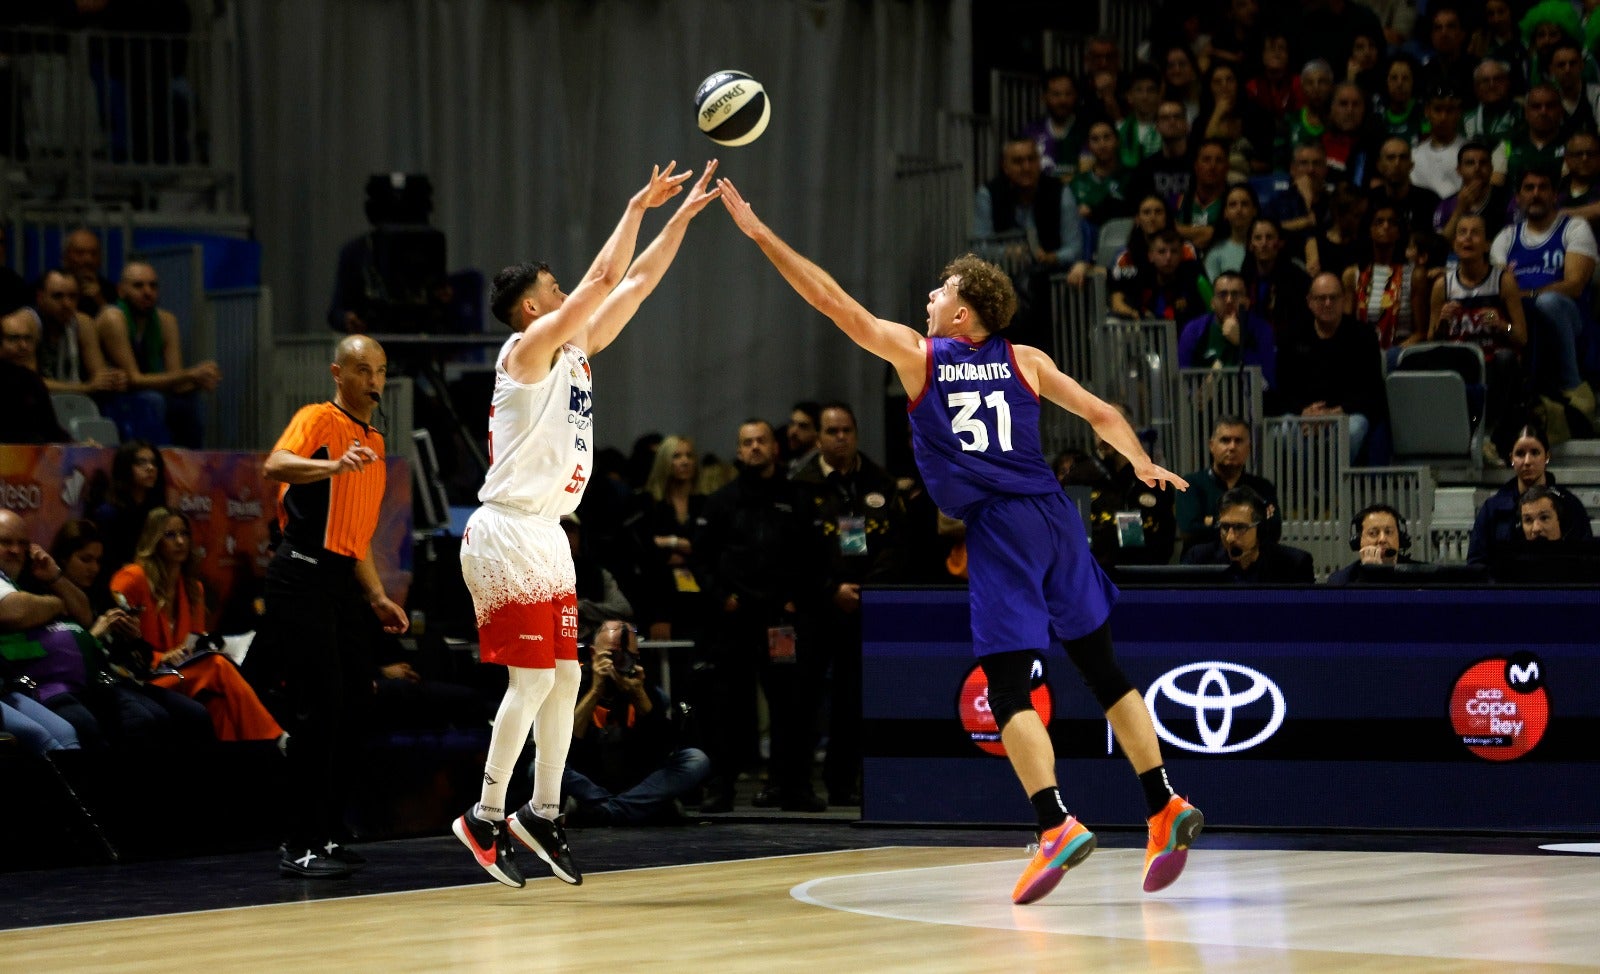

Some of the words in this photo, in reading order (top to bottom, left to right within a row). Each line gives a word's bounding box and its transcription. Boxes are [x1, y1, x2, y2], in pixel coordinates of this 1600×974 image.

[702, 83, 746, 122] SPALDING
[938, 362, 1012, 382] JOKUBAITIS
[948, 390, 1014, 452] 31
[1465, 698, 1517, 717] Copa
[1490, 716, 1524, 738] Rey
